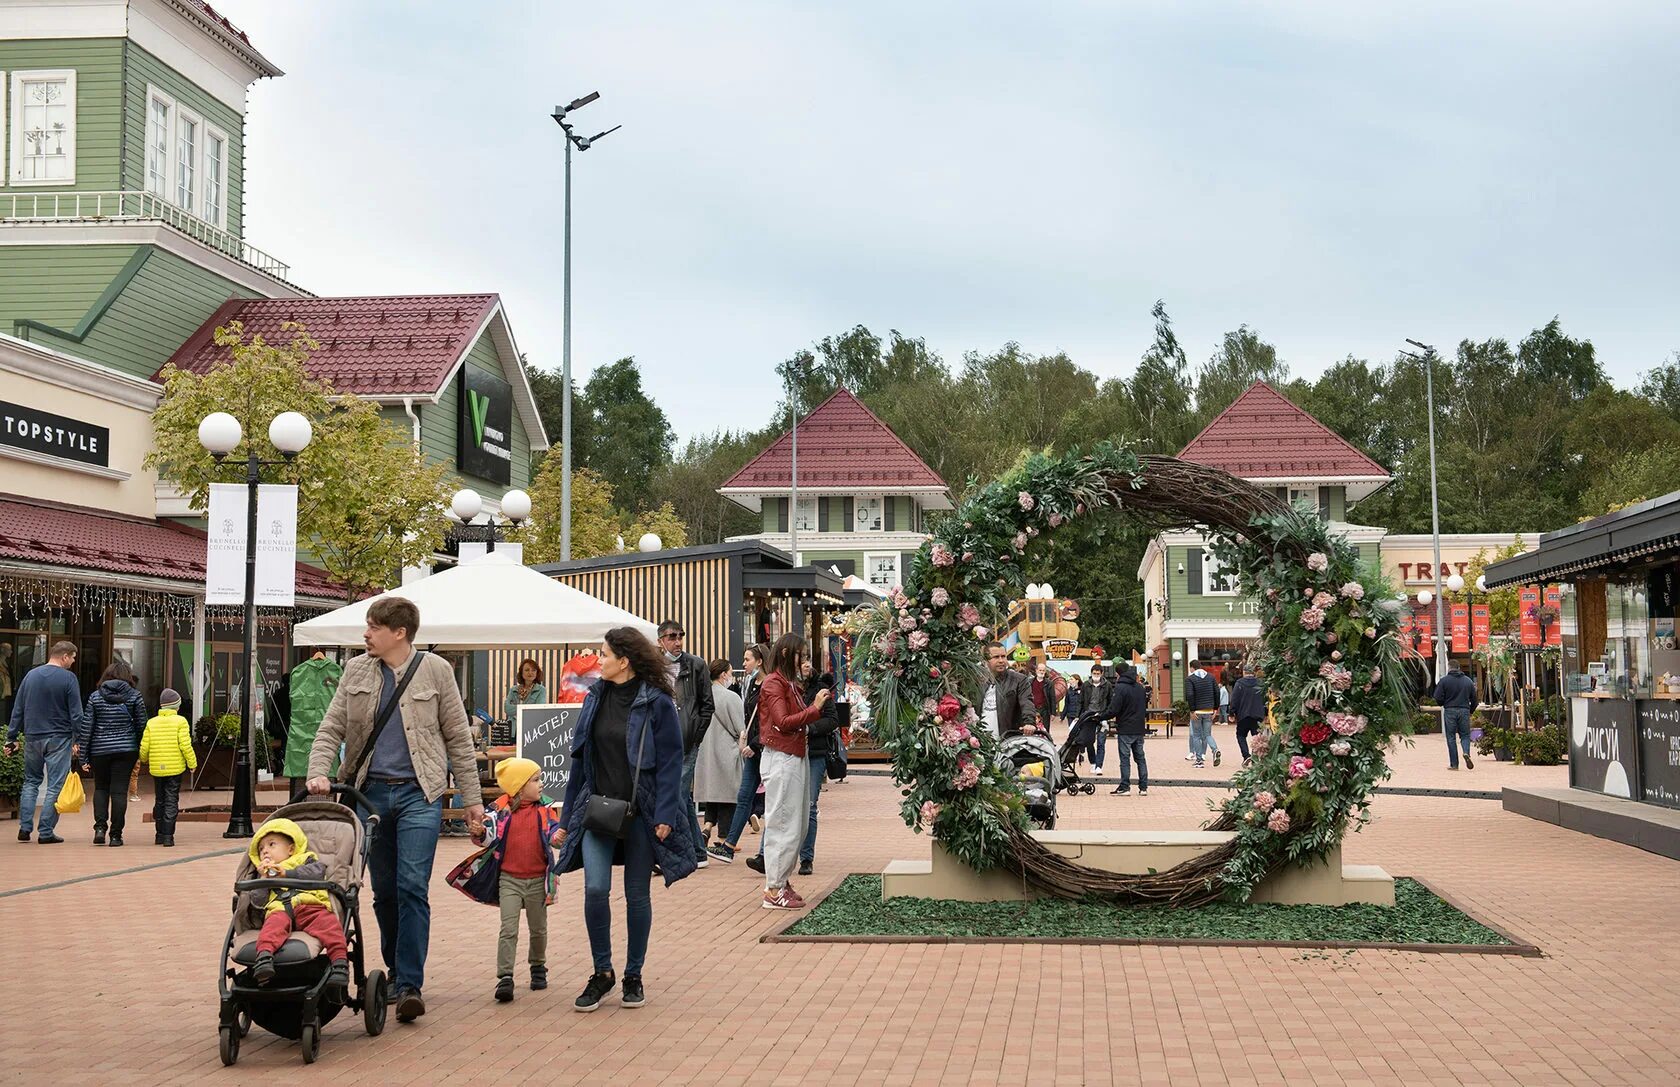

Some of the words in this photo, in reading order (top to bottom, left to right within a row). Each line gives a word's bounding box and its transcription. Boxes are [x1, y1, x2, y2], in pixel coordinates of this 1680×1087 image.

[5, 416, 97, 453] TOPSTYLE
[524, 711, 569, 747] МАСТЕР
[1586, 721, 1620, 761] РИСУЙ
[544, 754, 564, 767] ПО
